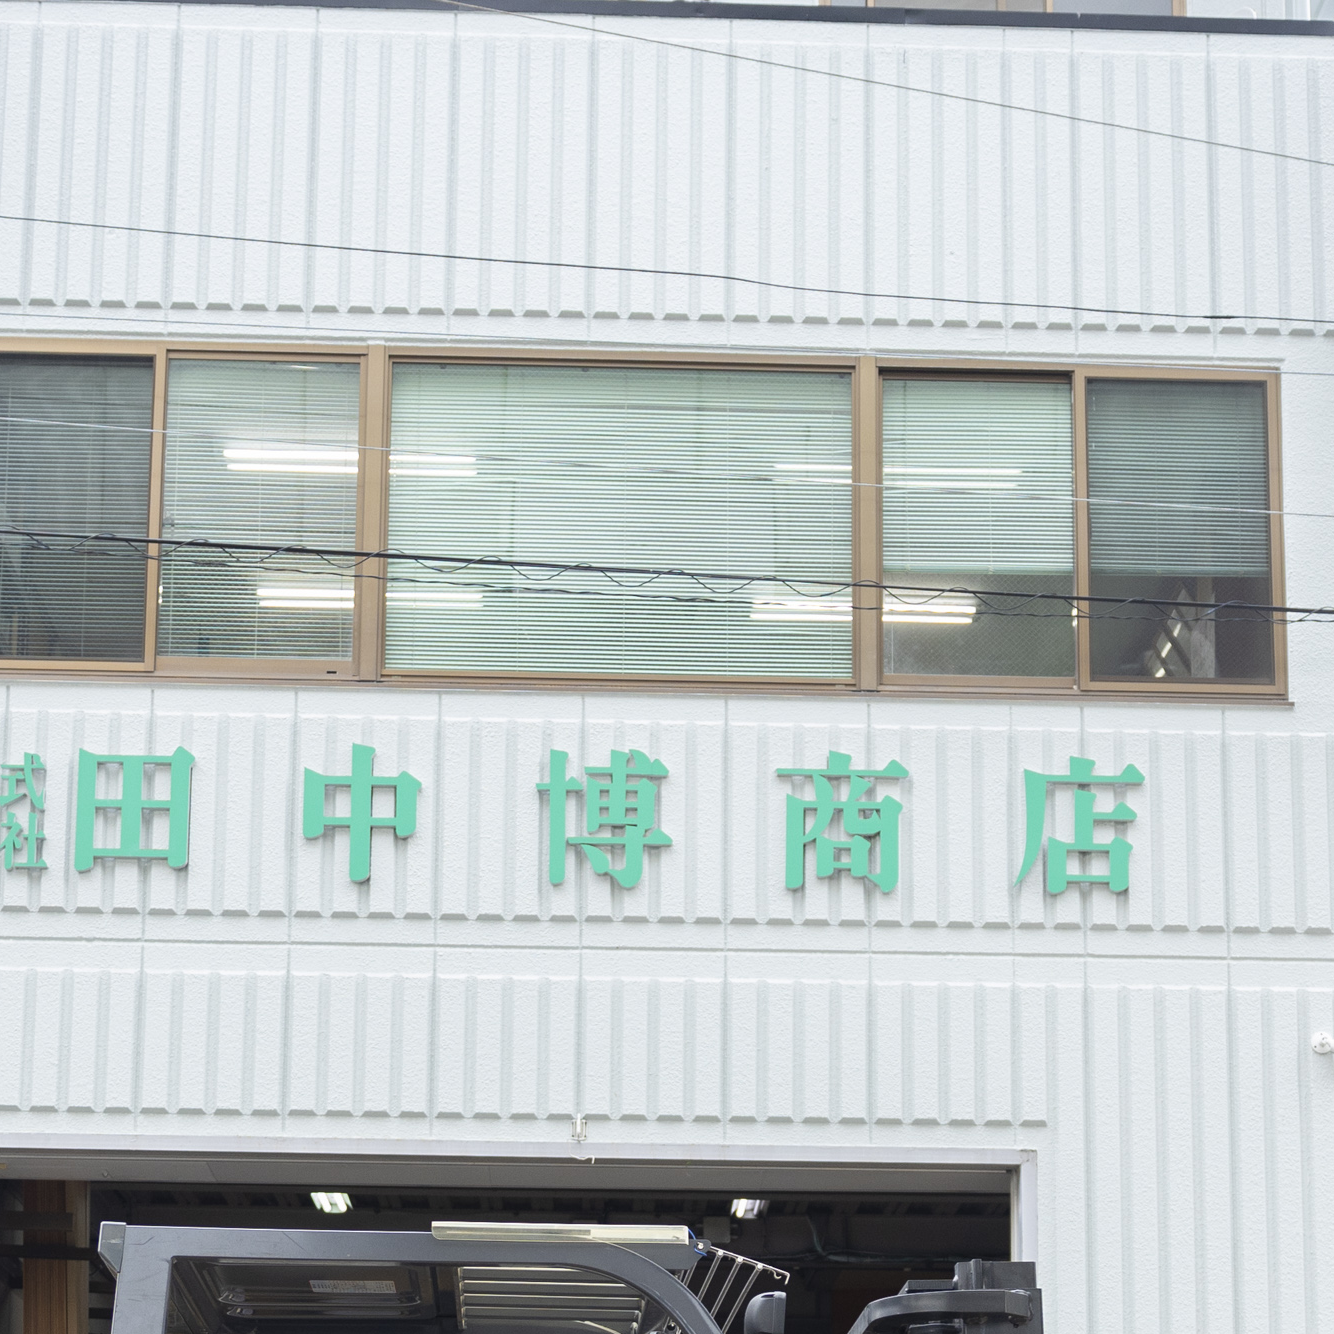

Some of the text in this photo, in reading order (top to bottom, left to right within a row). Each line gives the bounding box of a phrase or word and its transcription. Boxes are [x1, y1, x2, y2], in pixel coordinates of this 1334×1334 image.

[74, 744, 1146, 893] 田中博商店
